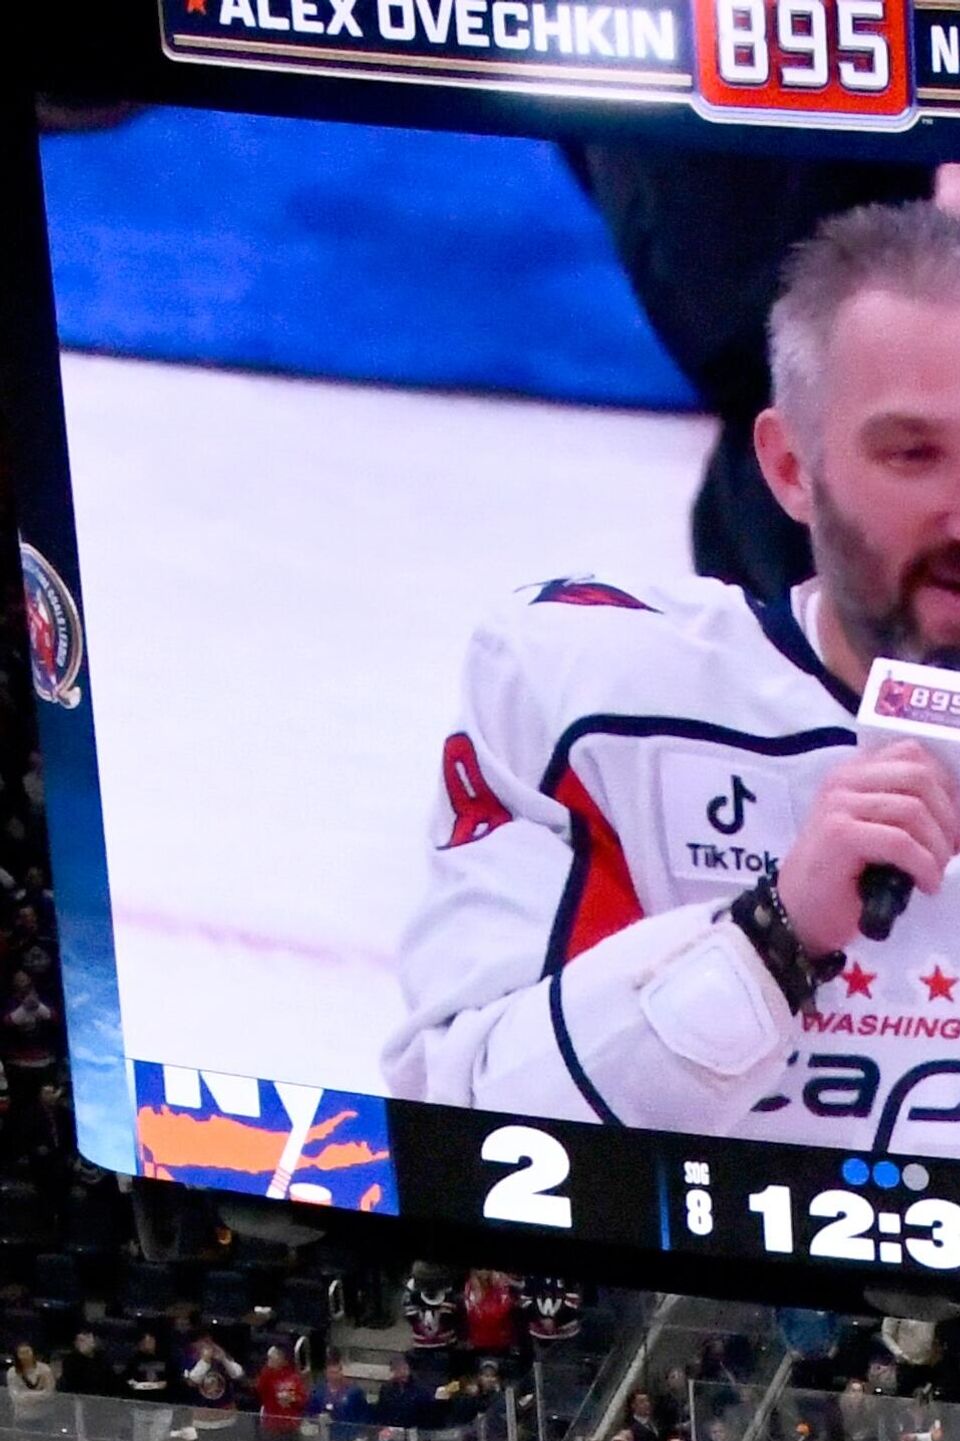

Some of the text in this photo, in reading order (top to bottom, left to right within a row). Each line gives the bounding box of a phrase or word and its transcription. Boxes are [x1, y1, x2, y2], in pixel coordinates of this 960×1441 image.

[219, 0, 675, 60] ALEX OVECHKIN
[717, 0, 890, 90] 895
[686, 842, 781, 874] TikTok
[481, 1125, 572, 1228] 2
[684, 1160, 709, 1185] SOG
[685, 1189, 713, 1236] 8
